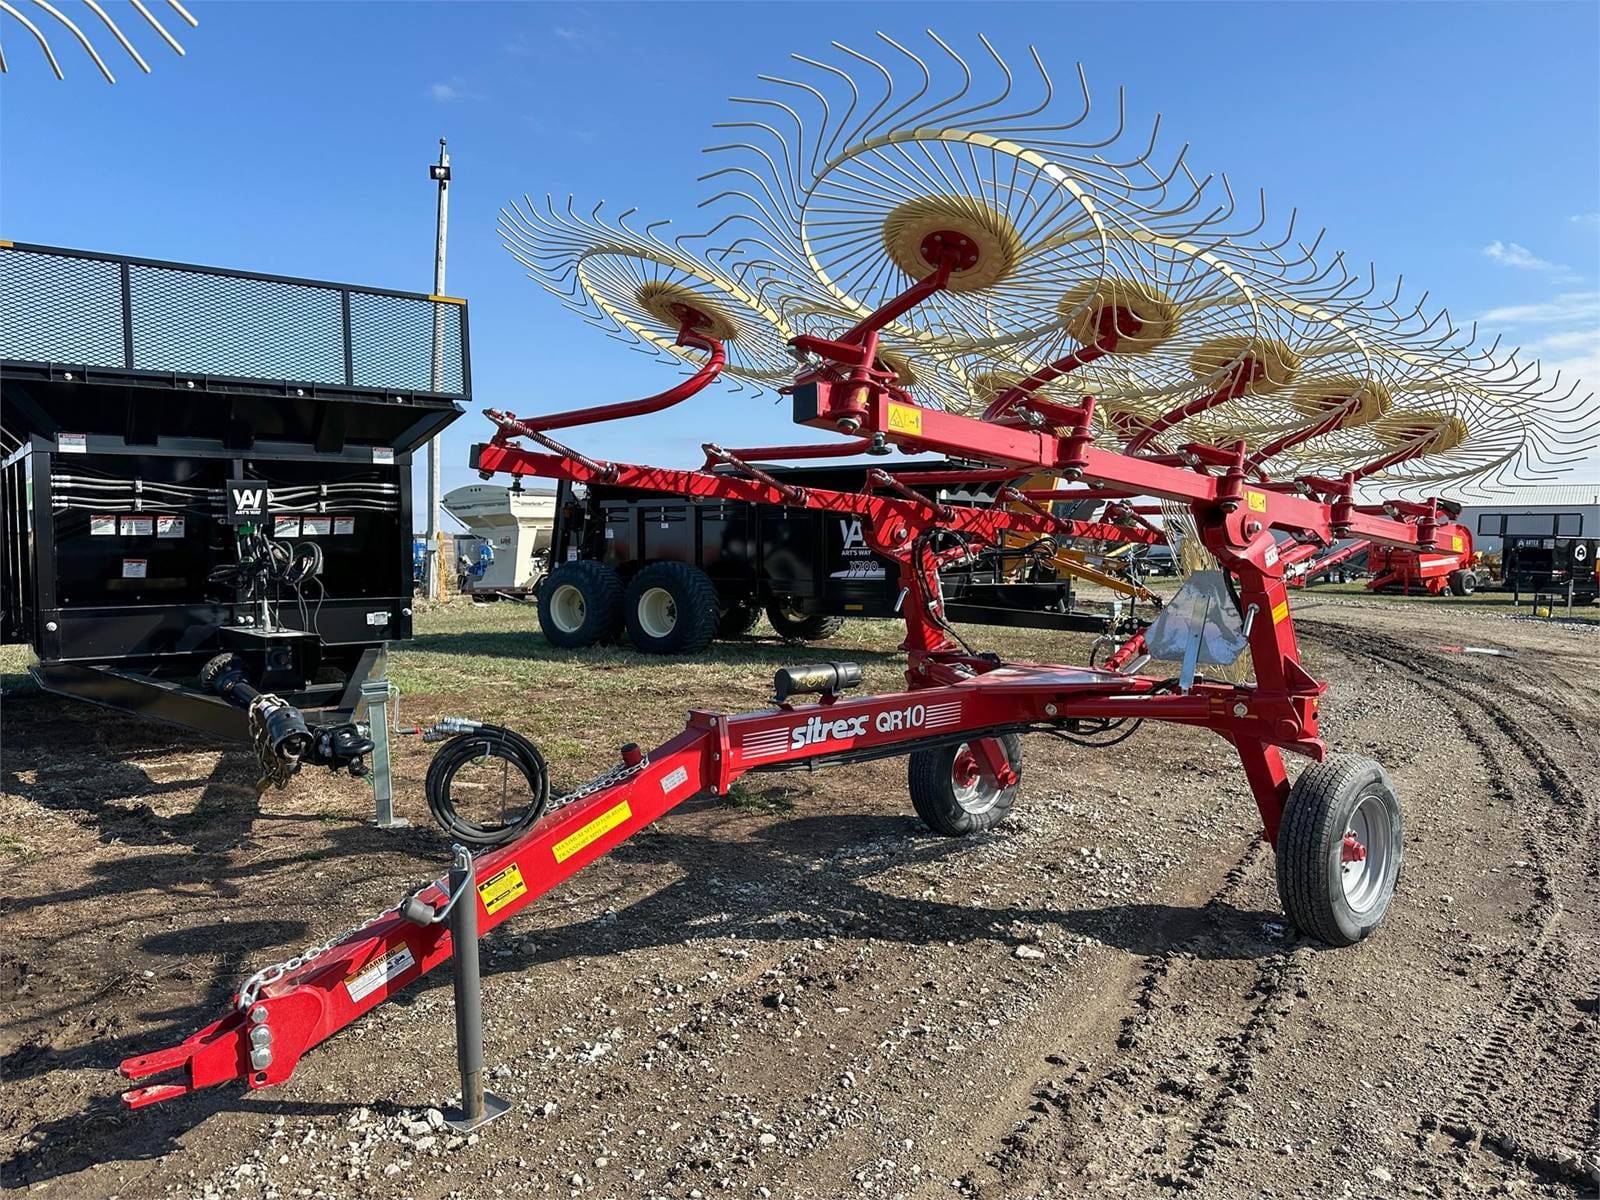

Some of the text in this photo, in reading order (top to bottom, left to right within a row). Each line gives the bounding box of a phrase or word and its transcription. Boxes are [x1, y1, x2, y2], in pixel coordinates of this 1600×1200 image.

[850, 560, 878, 572] X700
[791, 704, 925, 750] sitrex QR10
[363, 949, 396, 973] WARNING
